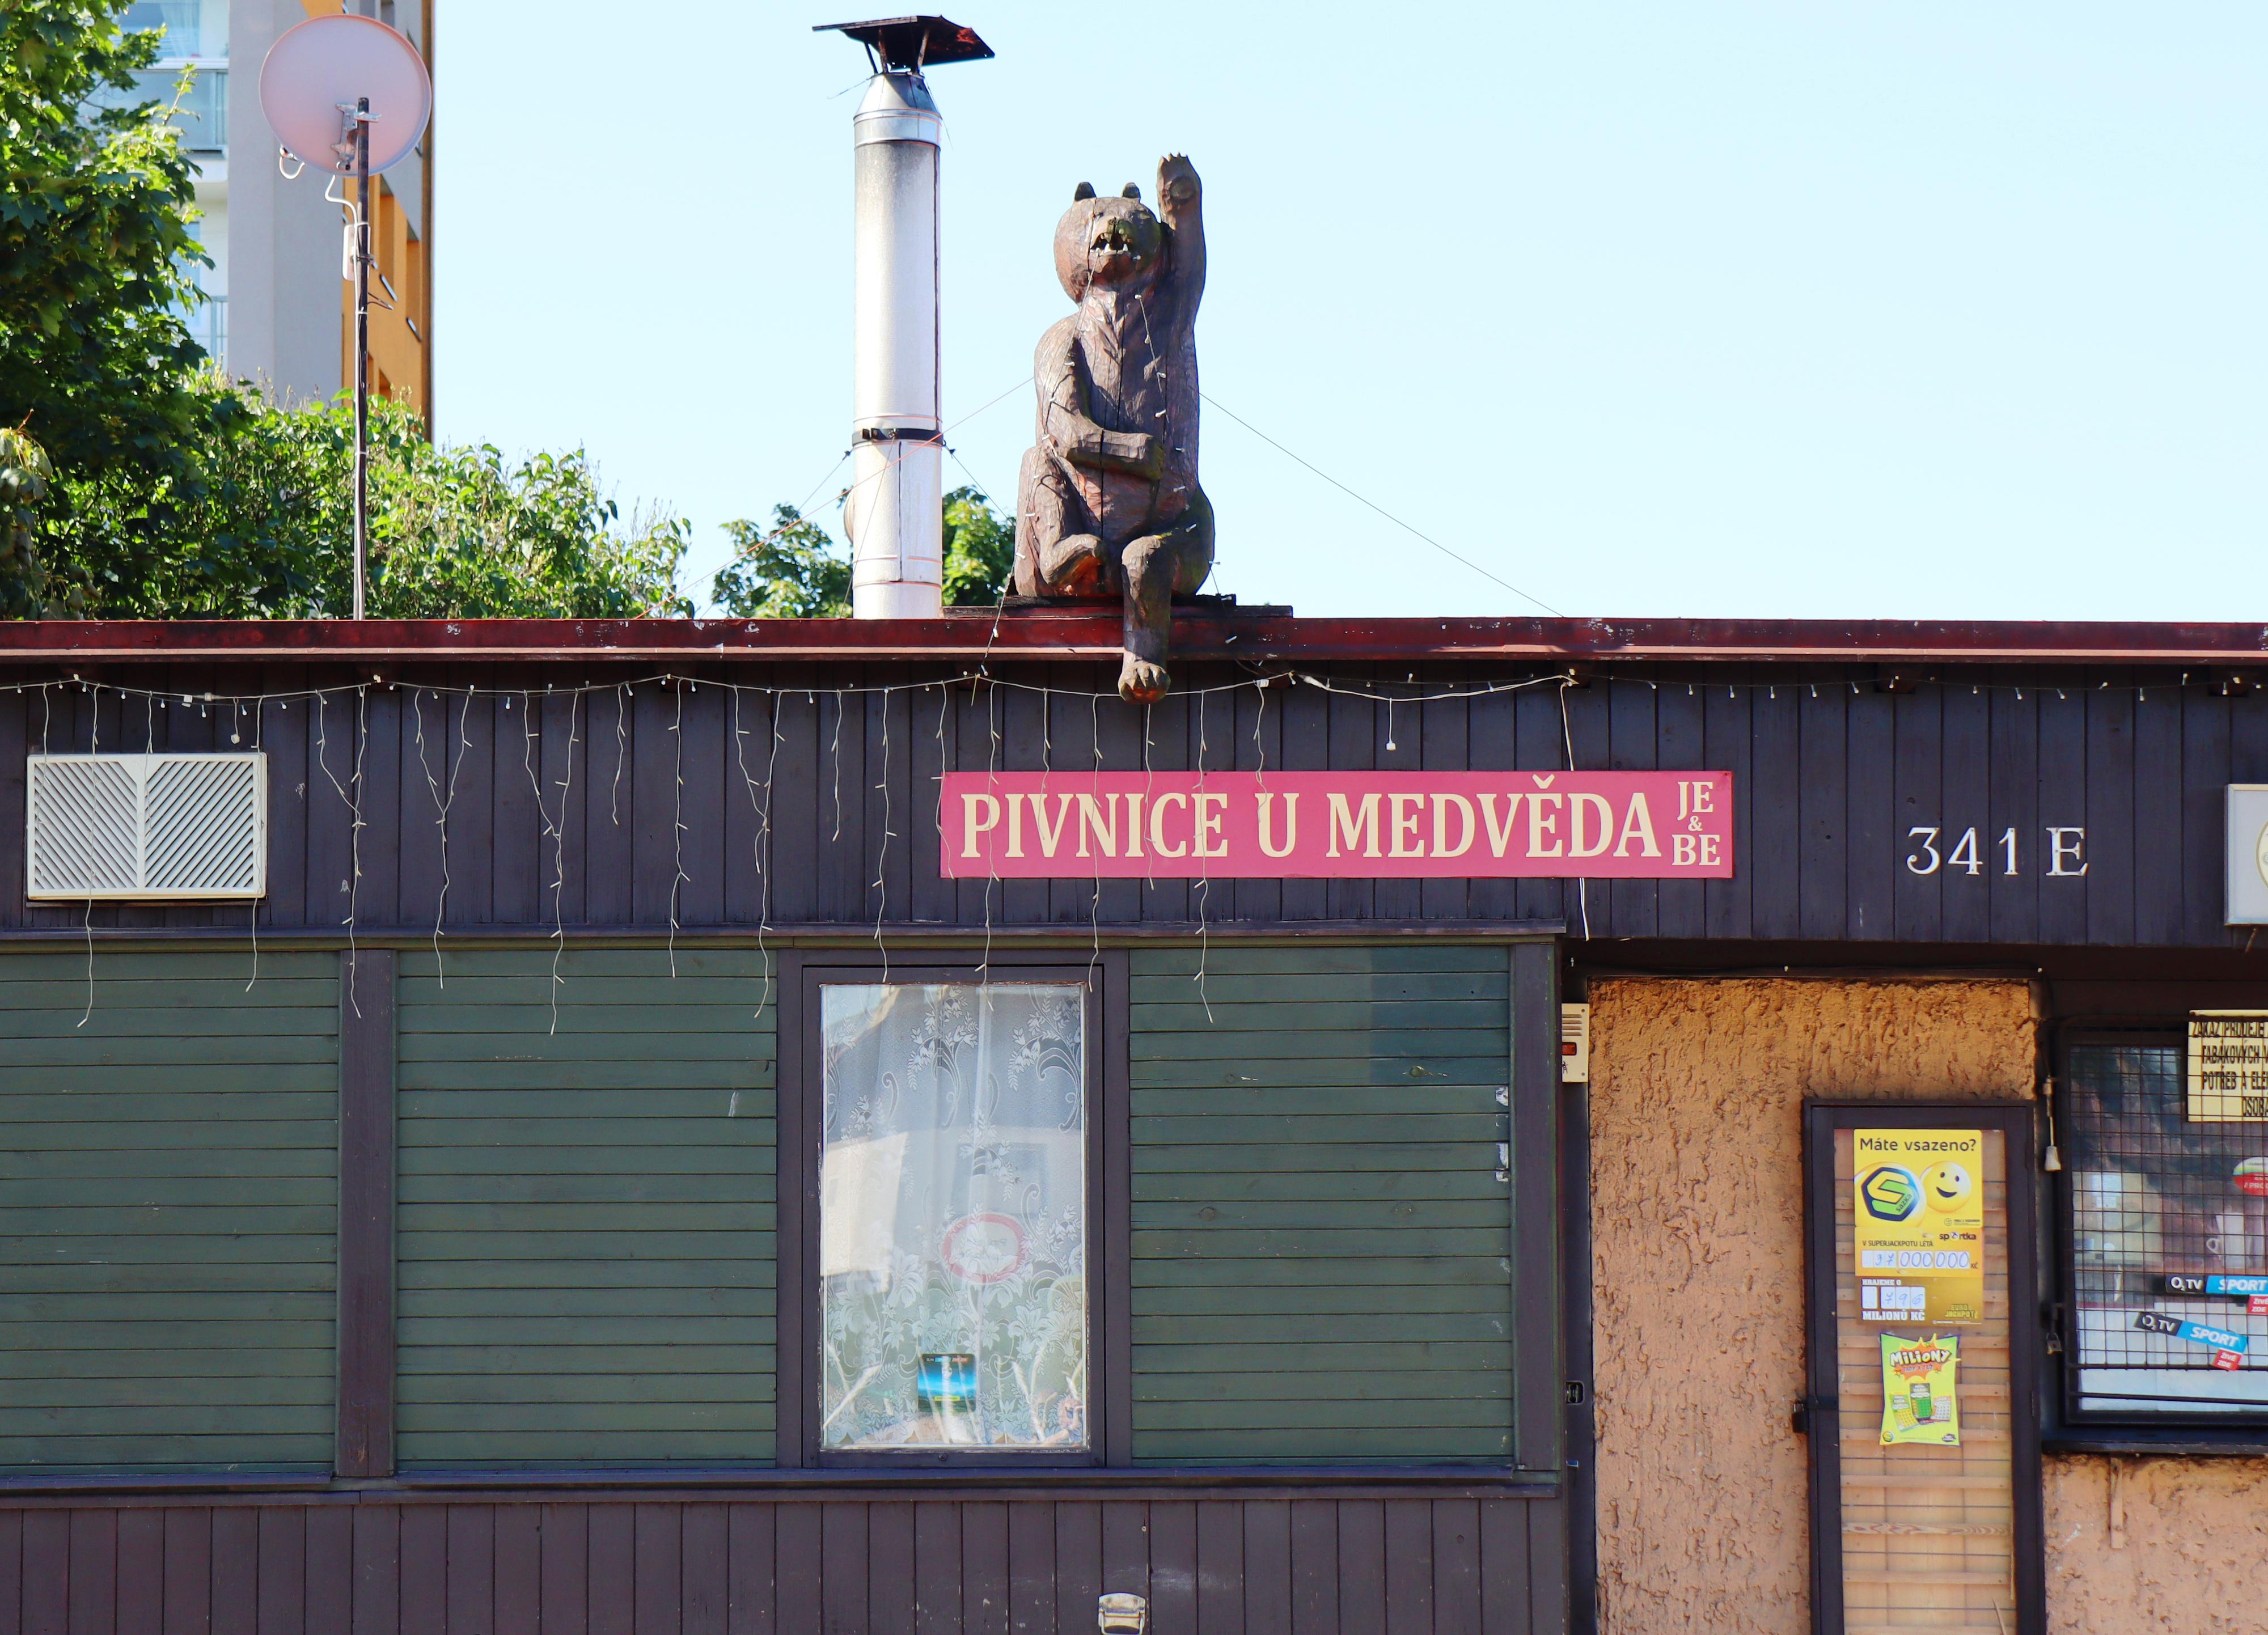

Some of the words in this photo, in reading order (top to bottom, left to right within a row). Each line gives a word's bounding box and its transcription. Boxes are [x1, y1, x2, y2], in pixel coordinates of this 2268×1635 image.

[1677, 781, 1713, 820] JE
[960, 793, 1228, 858] PIVNICE
[1254, 793, 1297, 858] U
[1326, 773, 1661, 858] MEDVĚDA
[1688, 815, 1703, 831] &
[1672, 834, 1720, 865] BE
[1906, 827, 2019, 875] 341
[2045, 827, 2088, 876] E
[1860, 1137, 1898, 1150] Máte
[1905, 1139, 1977, 1151] vsazeno?
[2218, 1279, 2267, 1291] SPORT
[1862, 1309, 1907, 1321] MILIONŮ
[2190, 1327, 2240, 1348] SPORT
